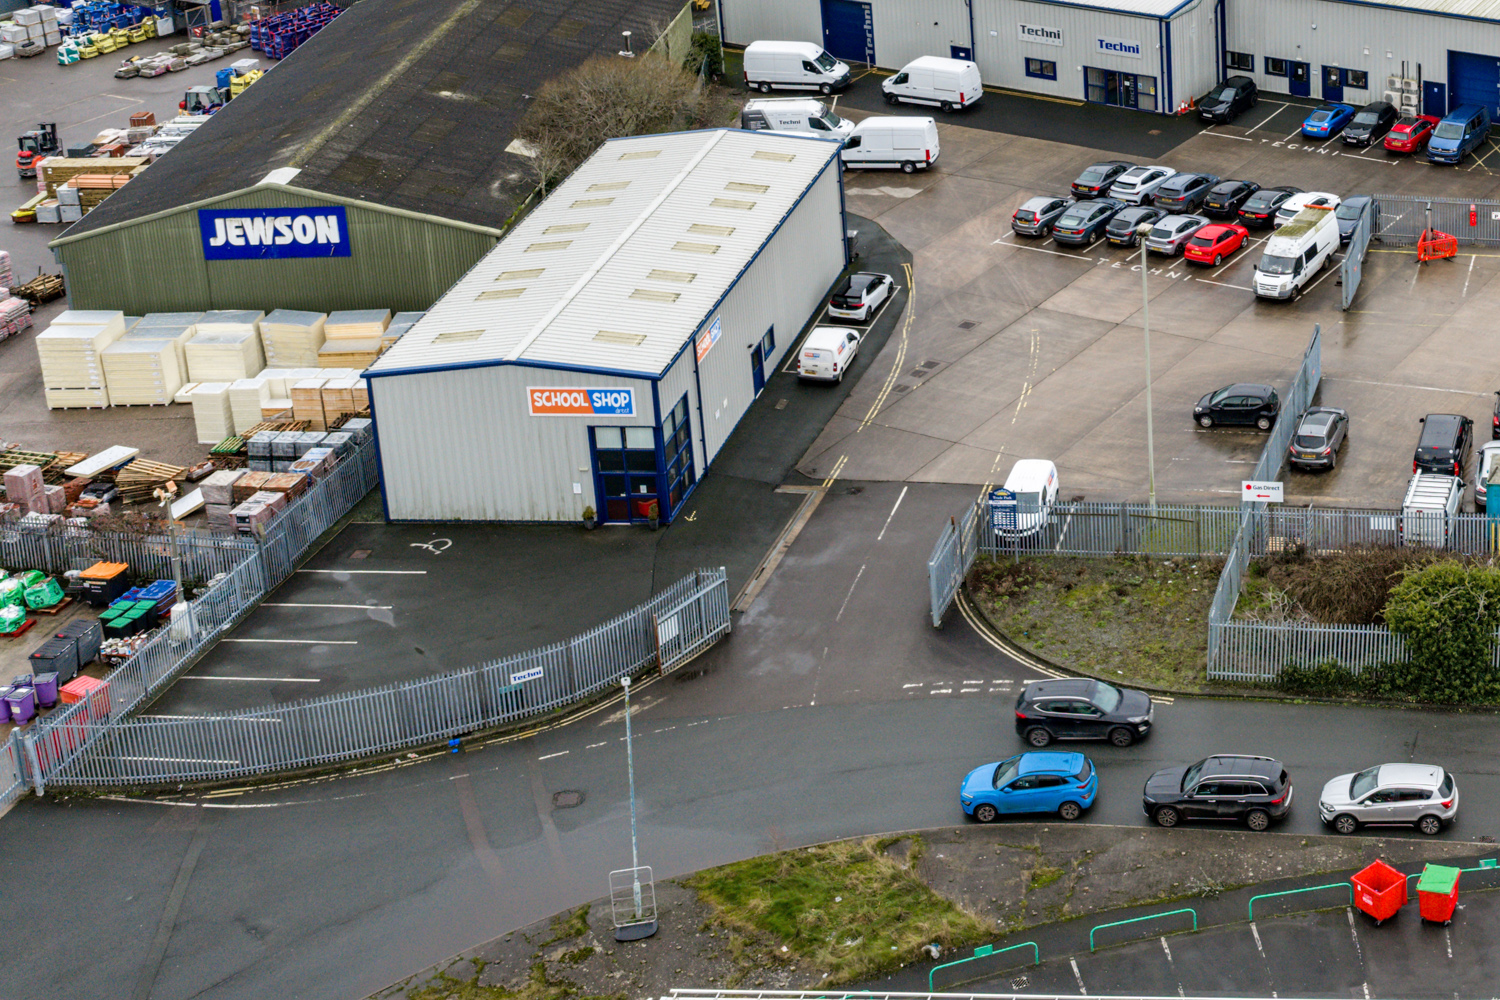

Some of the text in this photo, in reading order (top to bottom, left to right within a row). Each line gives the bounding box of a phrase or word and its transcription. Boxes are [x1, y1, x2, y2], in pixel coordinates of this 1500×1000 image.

[1019, 24, 1061, 40] Techni
[1097, 38, 1140, 55] Techni
[209, 215, 341, 246] JEWSON
[532, 391, 630, 408] SCHOOL SHOP
[512, 669, 542, 682] Techni
